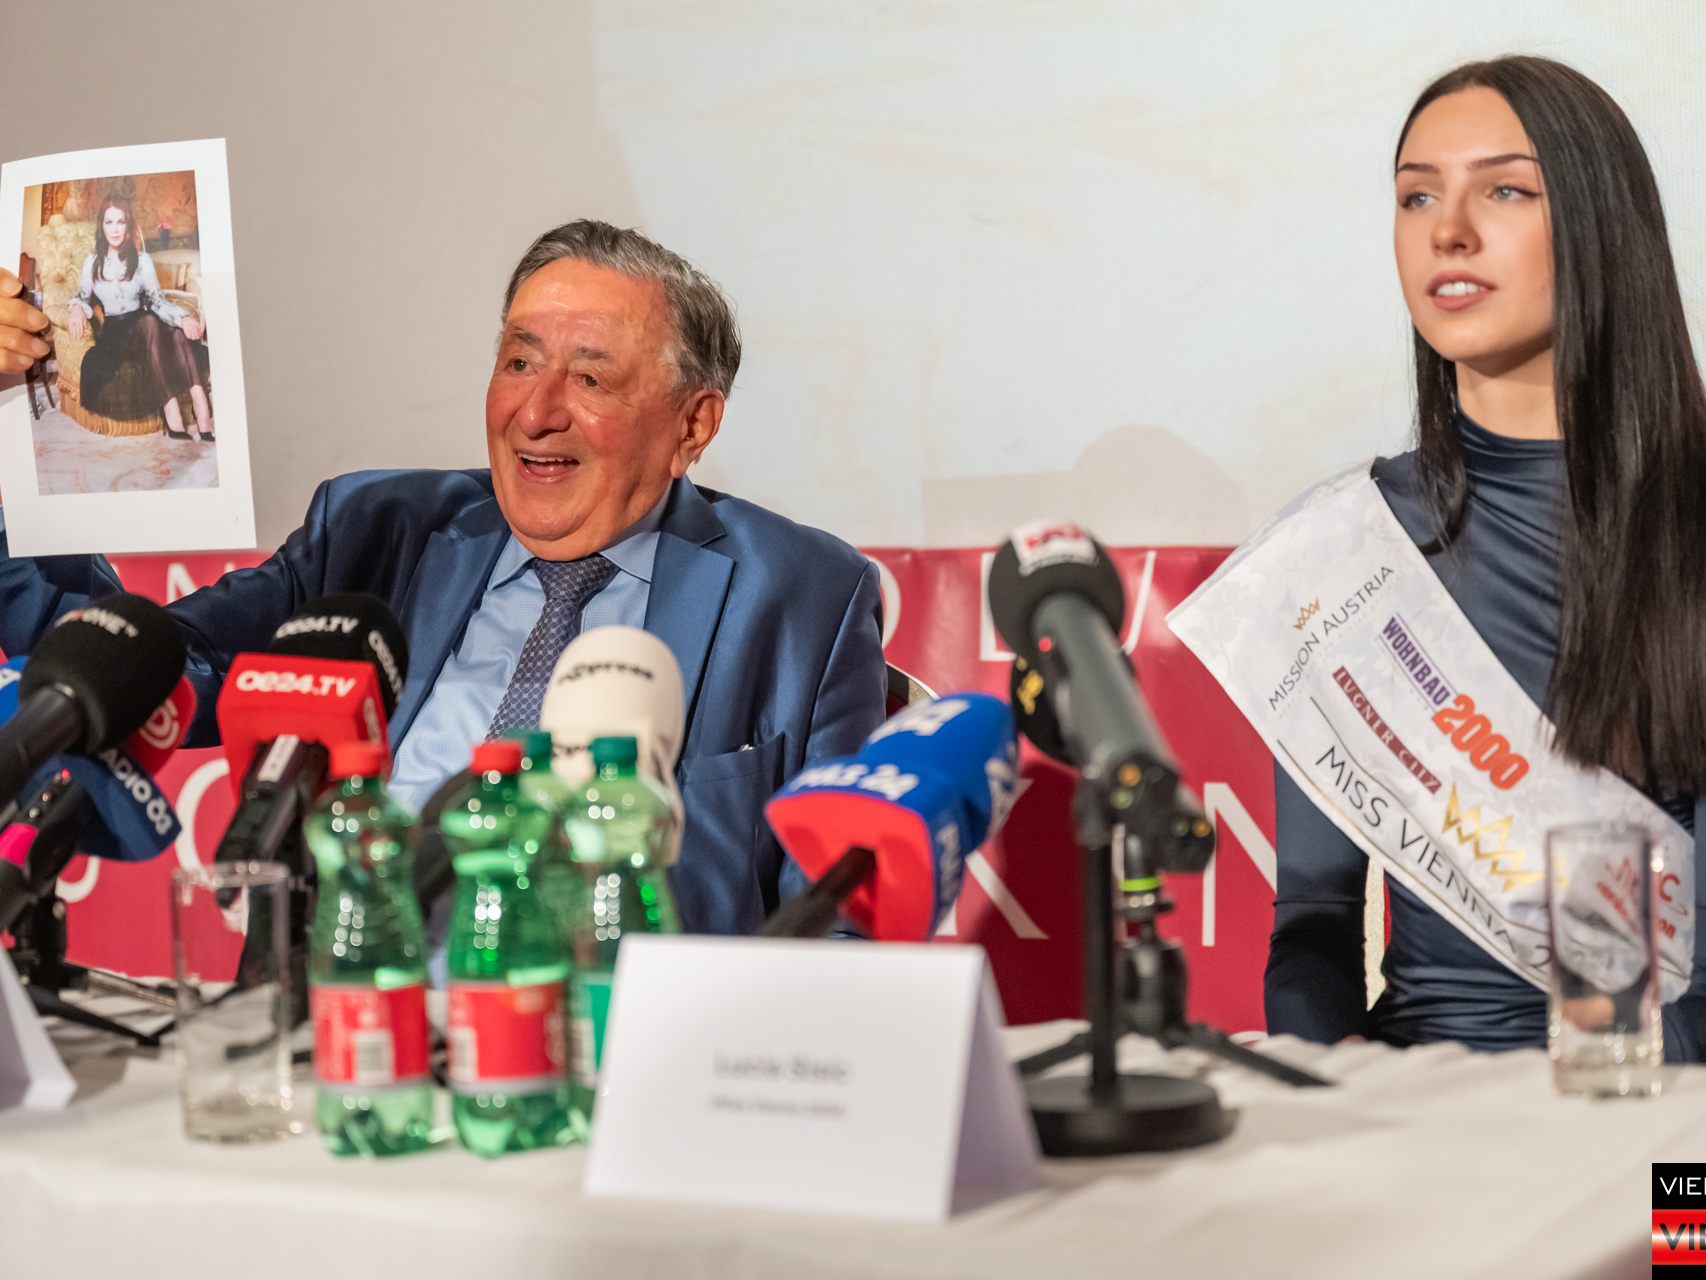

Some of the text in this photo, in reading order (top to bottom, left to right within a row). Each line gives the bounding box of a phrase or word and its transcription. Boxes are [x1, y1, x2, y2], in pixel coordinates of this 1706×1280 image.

[1268, 565, 1394, 711] MISSION AUSTRIA
[1381, 616, 1450, 706] WOHNBAU
[97, 746, 153, 802] ADIO
[1431, 693, 1530, 791] 2000
[1315, 745, 1389, 828] MISS
[1400, 818, 1517, 954] VIENNA
